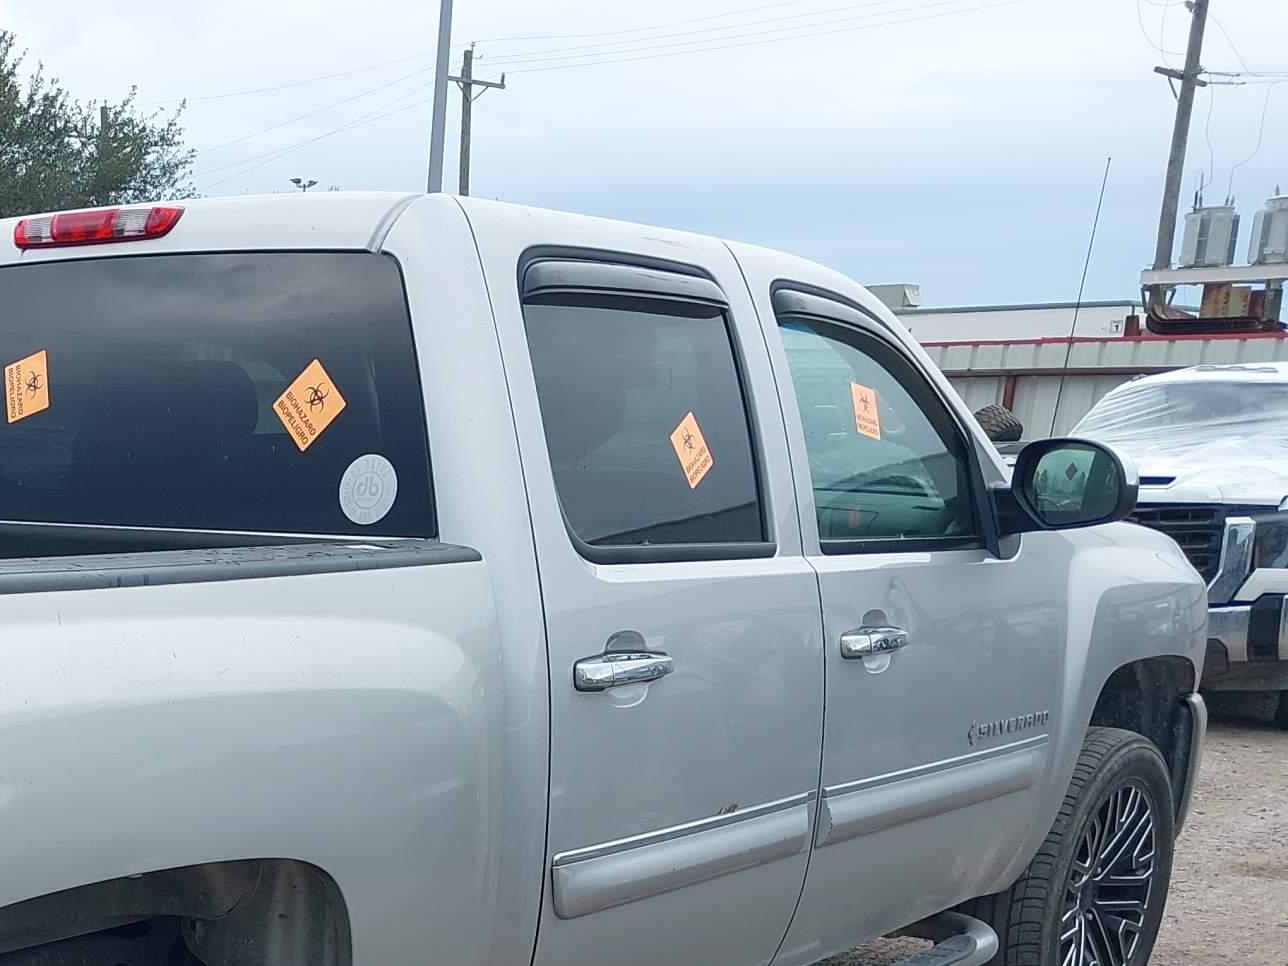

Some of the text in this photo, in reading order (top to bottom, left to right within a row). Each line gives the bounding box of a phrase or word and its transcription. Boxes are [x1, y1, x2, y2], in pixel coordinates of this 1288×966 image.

[8, 367, 17, 419] BIOPELIGRO
[15, 364, 24, 416] BIOHAZARD
[285, 391, 317, 436] BIOHAZARD
[277, 399, 309, 446] BIOPELIGRO
[978, 710, 1049, 738] SILVERADO
